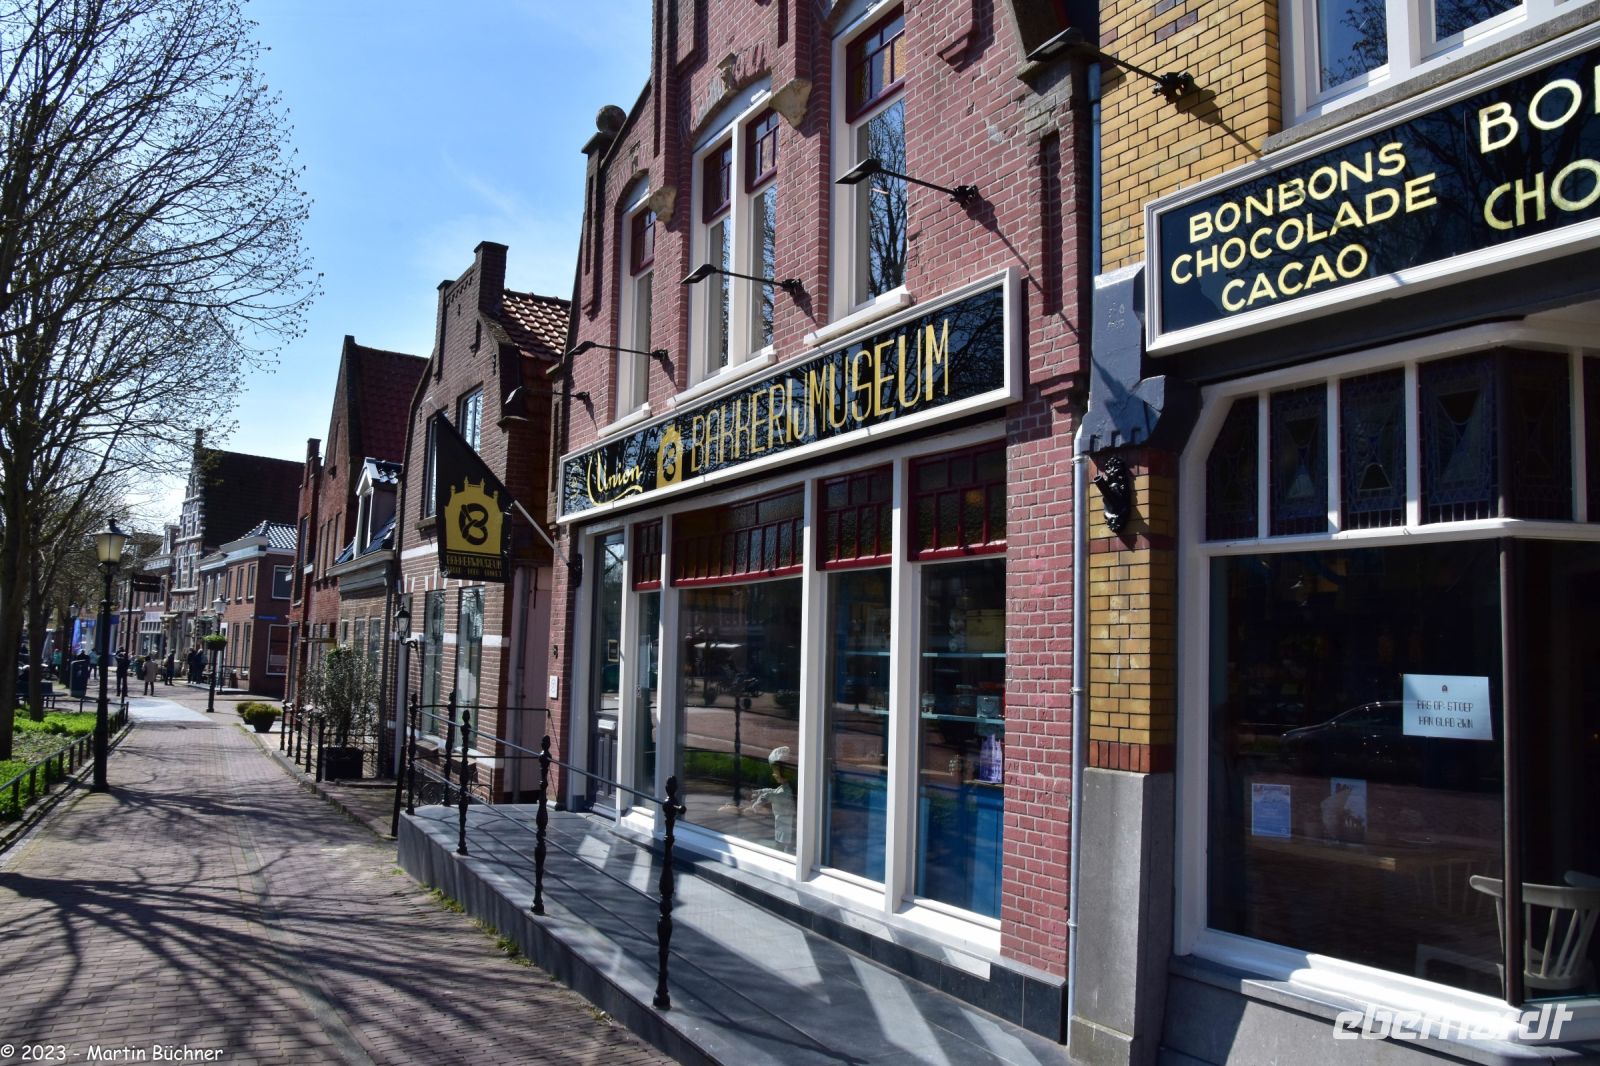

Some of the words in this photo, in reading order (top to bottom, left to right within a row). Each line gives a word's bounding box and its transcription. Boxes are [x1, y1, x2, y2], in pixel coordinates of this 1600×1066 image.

[1170, 172, 1438, 285] CHOCOLADE
[1189, 142, 1406, 243] BONBONS
[1221, 243, 1368, 312] CACAO
[587, 449, 643, 506] Union
[691, 319, 948, 472] BAKKERIJMUSEUM
